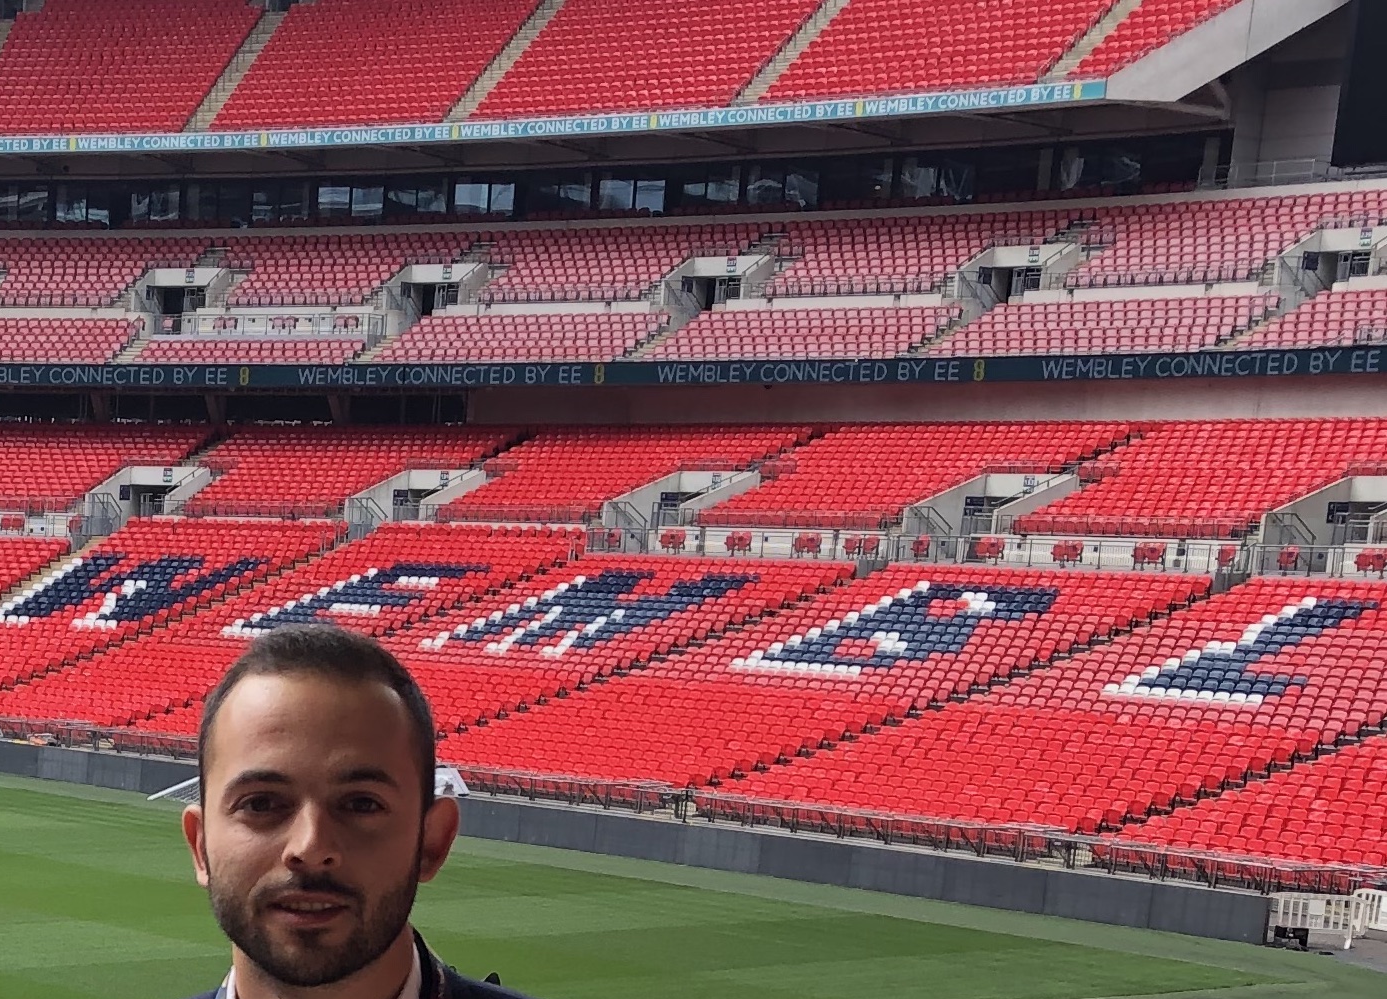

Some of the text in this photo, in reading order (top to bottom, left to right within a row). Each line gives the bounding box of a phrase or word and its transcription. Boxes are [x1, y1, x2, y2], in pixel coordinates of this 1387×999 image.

[865, 86, 1070, 114] WEMBLEY CONNECTED BY EE
[658, 102, 852, 127] WEMBLEY CONNECTED BY EE
[268, 126, 449, 145] WEMBLEY CONNECTED BY EE
[460, 116, 647, 138] WEMBLEY CONNECTED BY EE
[33, 137, 52, 150] BY
[52, 137, 67, 150] EE
[78, 133, 258, 149] WEMBLEY CONNECTED BY EE
[298, 366, 394, 385] WEMBLEY
[395, 366, 515, 385] CONNECTED
[525, 365, 551, 384] BY
[558, 365, 582, 384] EE
[657, 363, 756, 383] WEMBLEY
[760, 361, 887, 382] CONNECTED
[898, 360, 926, 380] BY
[934, 360, 960, 380] EE
[1042, 350, 1381, 379] WEMBLEY CONNECTED BY EE
[49, 366, 164, 384] CONNECTED
[173, 366, 197, 385] BY
[205, 367, 227, 385] EE
